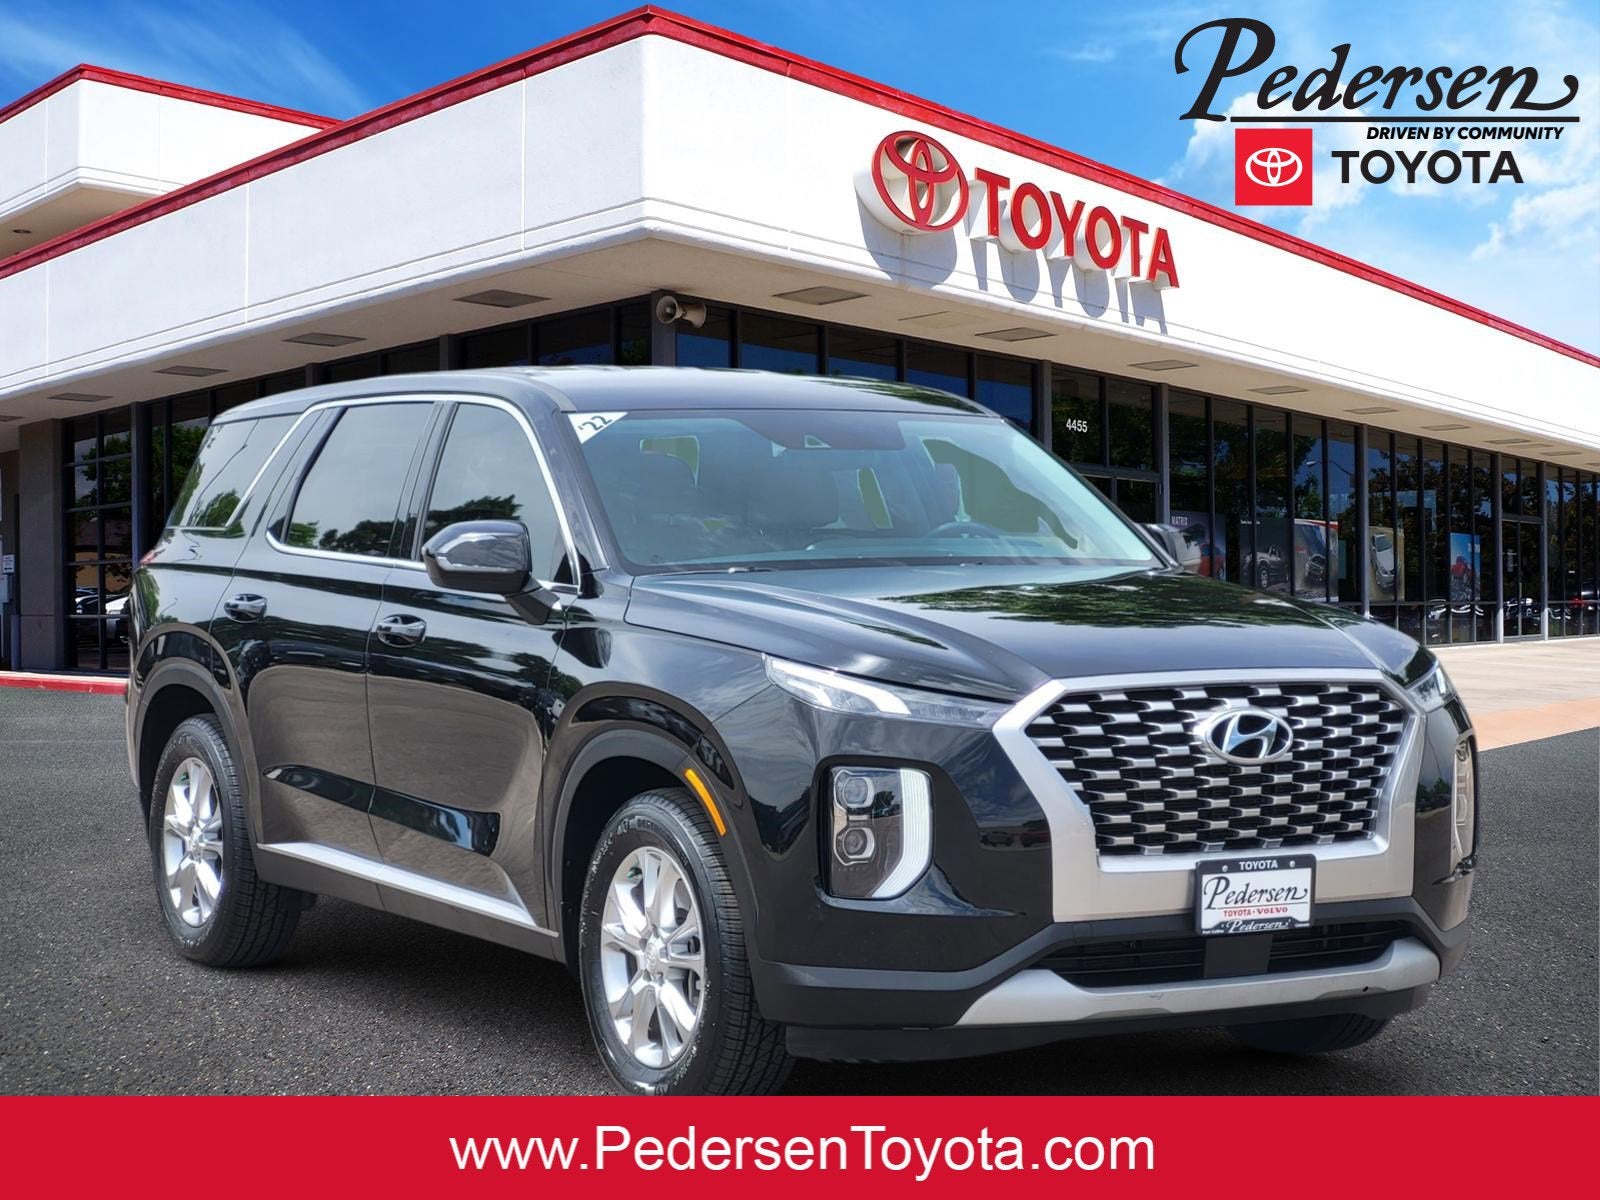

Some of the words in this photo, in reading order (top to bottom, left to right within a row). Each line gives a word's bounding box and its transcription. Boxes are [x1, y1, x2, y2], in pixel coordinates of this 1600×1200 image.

[974, 167, 1180, 289] TOYOTA
[1065, 418, 1088, 433] 4455
[1239, 859, 1279, 871] TOYOTA
[1203, 876, 1308, 910] Pedersen
[1223, 908, 1252, 918] TOYOTA
[1256, 906, 1288, 916] VOLVO
[1226, 919, 1290, 934] Pedersen
